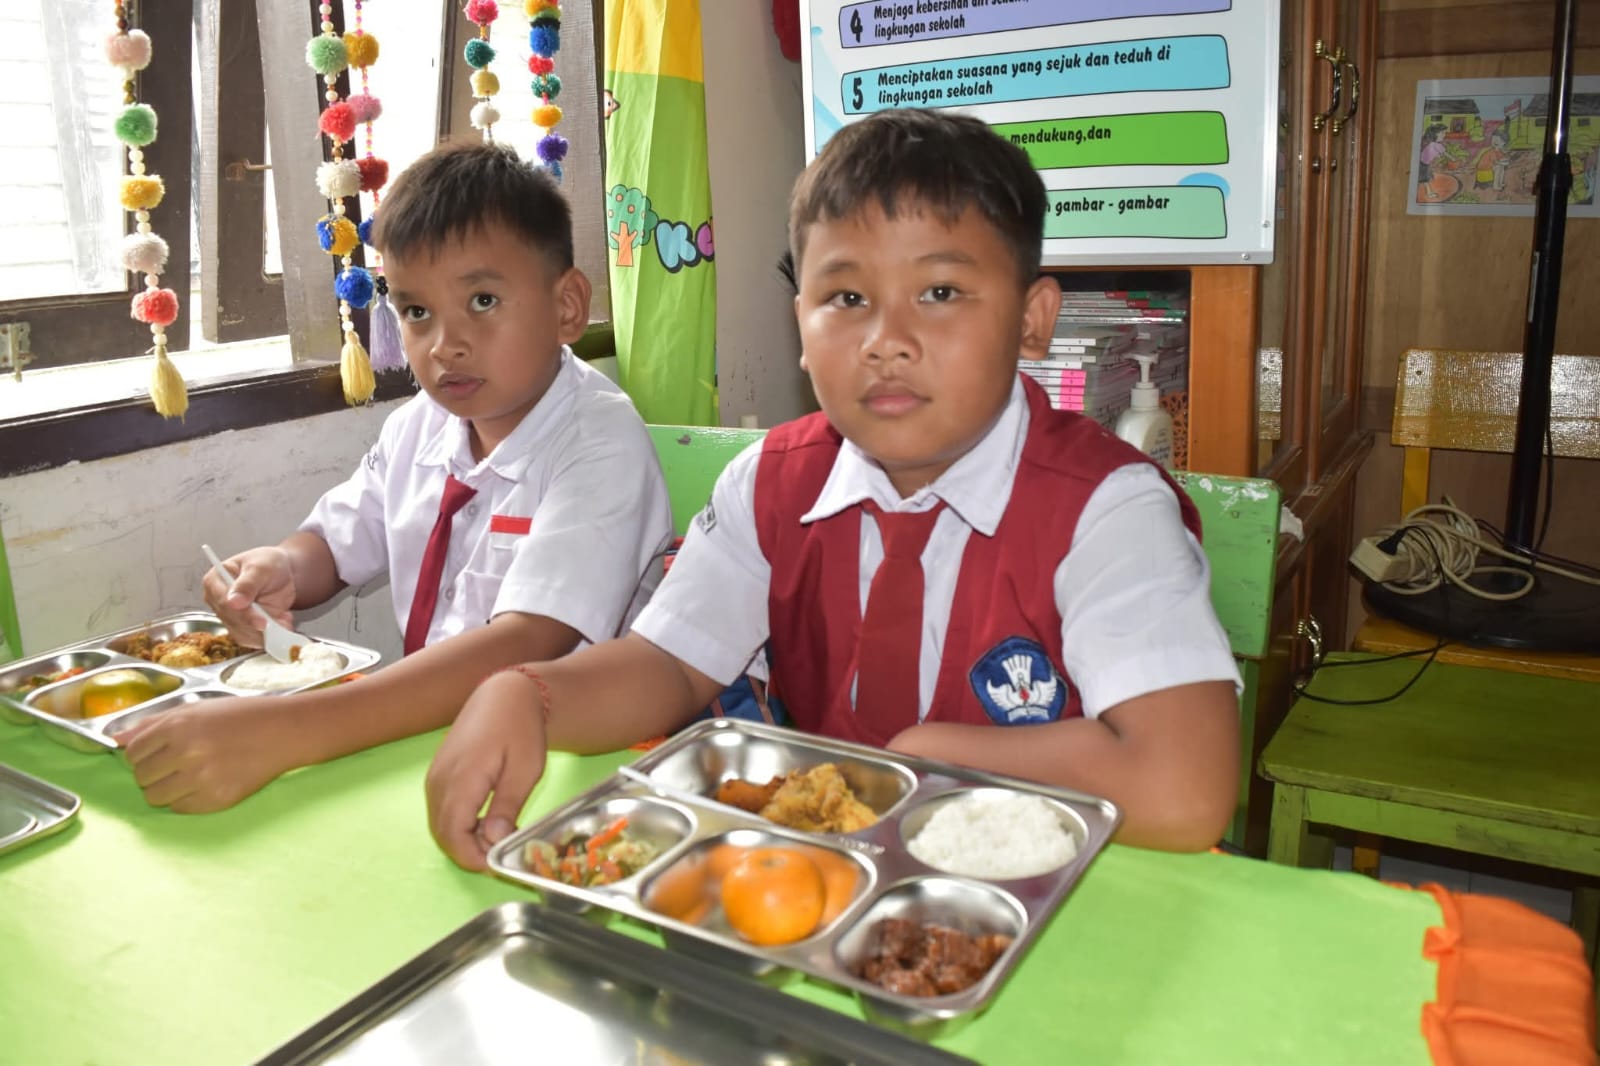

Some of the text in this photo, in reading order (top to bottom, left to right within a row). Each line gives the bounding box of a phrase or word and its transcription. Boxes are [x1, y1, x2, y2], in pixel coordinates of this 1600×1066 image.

[850, 9, 863, 43] 4
[874, 3, 913, 20] Menjaga
[875, 14, 965, 41] lingkungan sekolah
[852, 44, 1171, 110] 5 Menciptakan suasana yang sejuk dan teduh di
[878, 80, 993, 106] lingkungan sekolah
[1055, 197, 1105, 216] gambar
[1118, 195, 1170, 214] gambar
